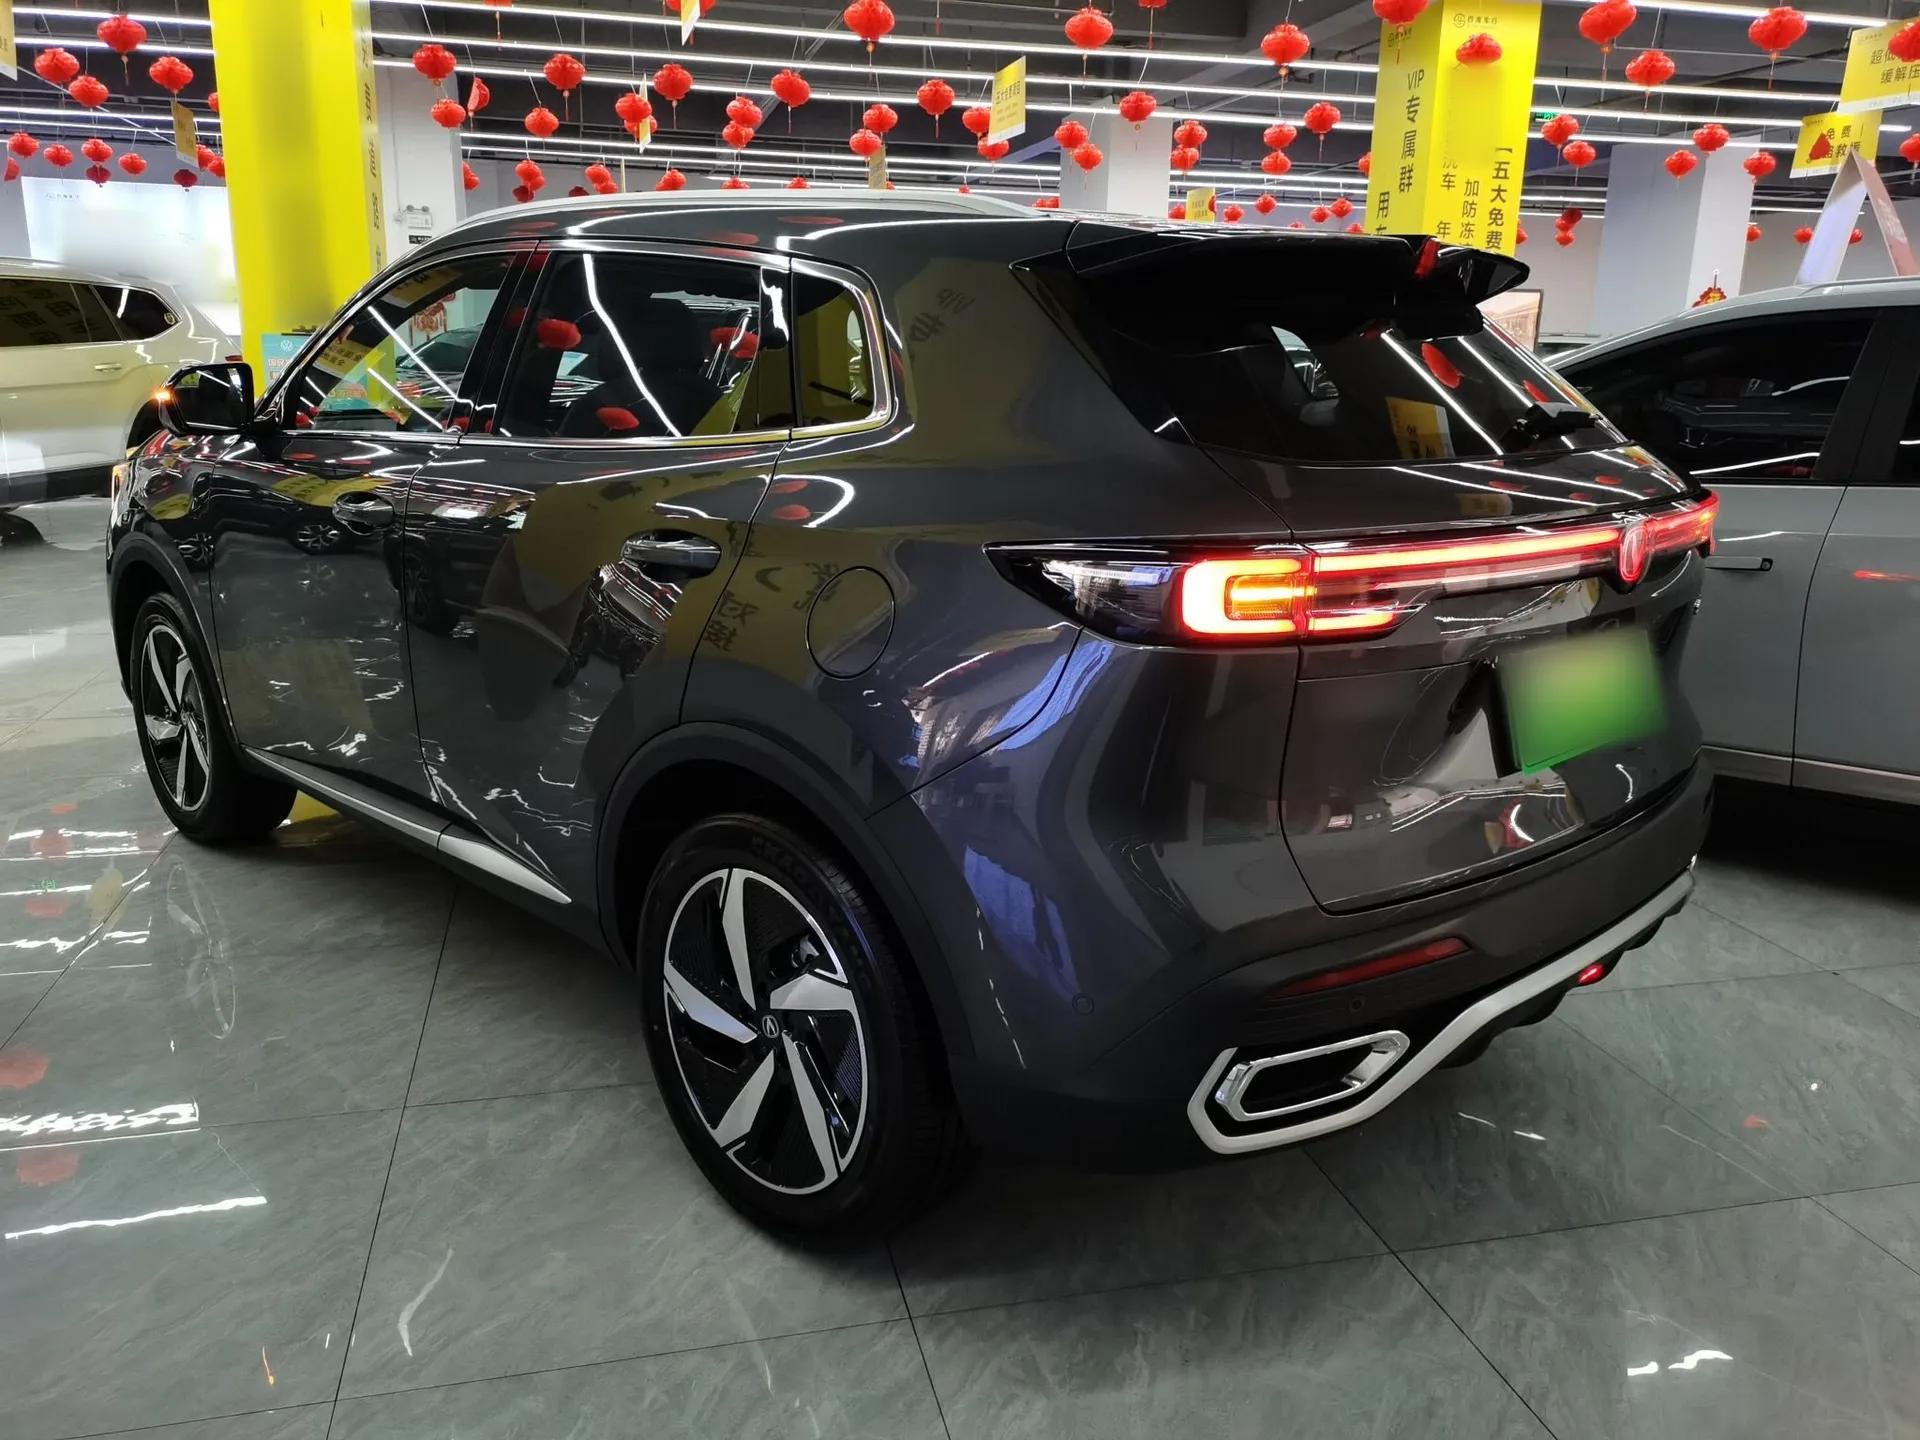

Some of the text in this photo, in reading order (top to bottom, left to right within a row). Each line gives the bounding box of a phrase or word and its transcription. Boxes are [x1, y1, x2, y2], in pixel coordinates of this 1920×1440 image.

[1827, 124, 1852, 140] 免费
[1459, 178, 1480, 246] 加防冻
[1436, 220, 1452, 239] 年
